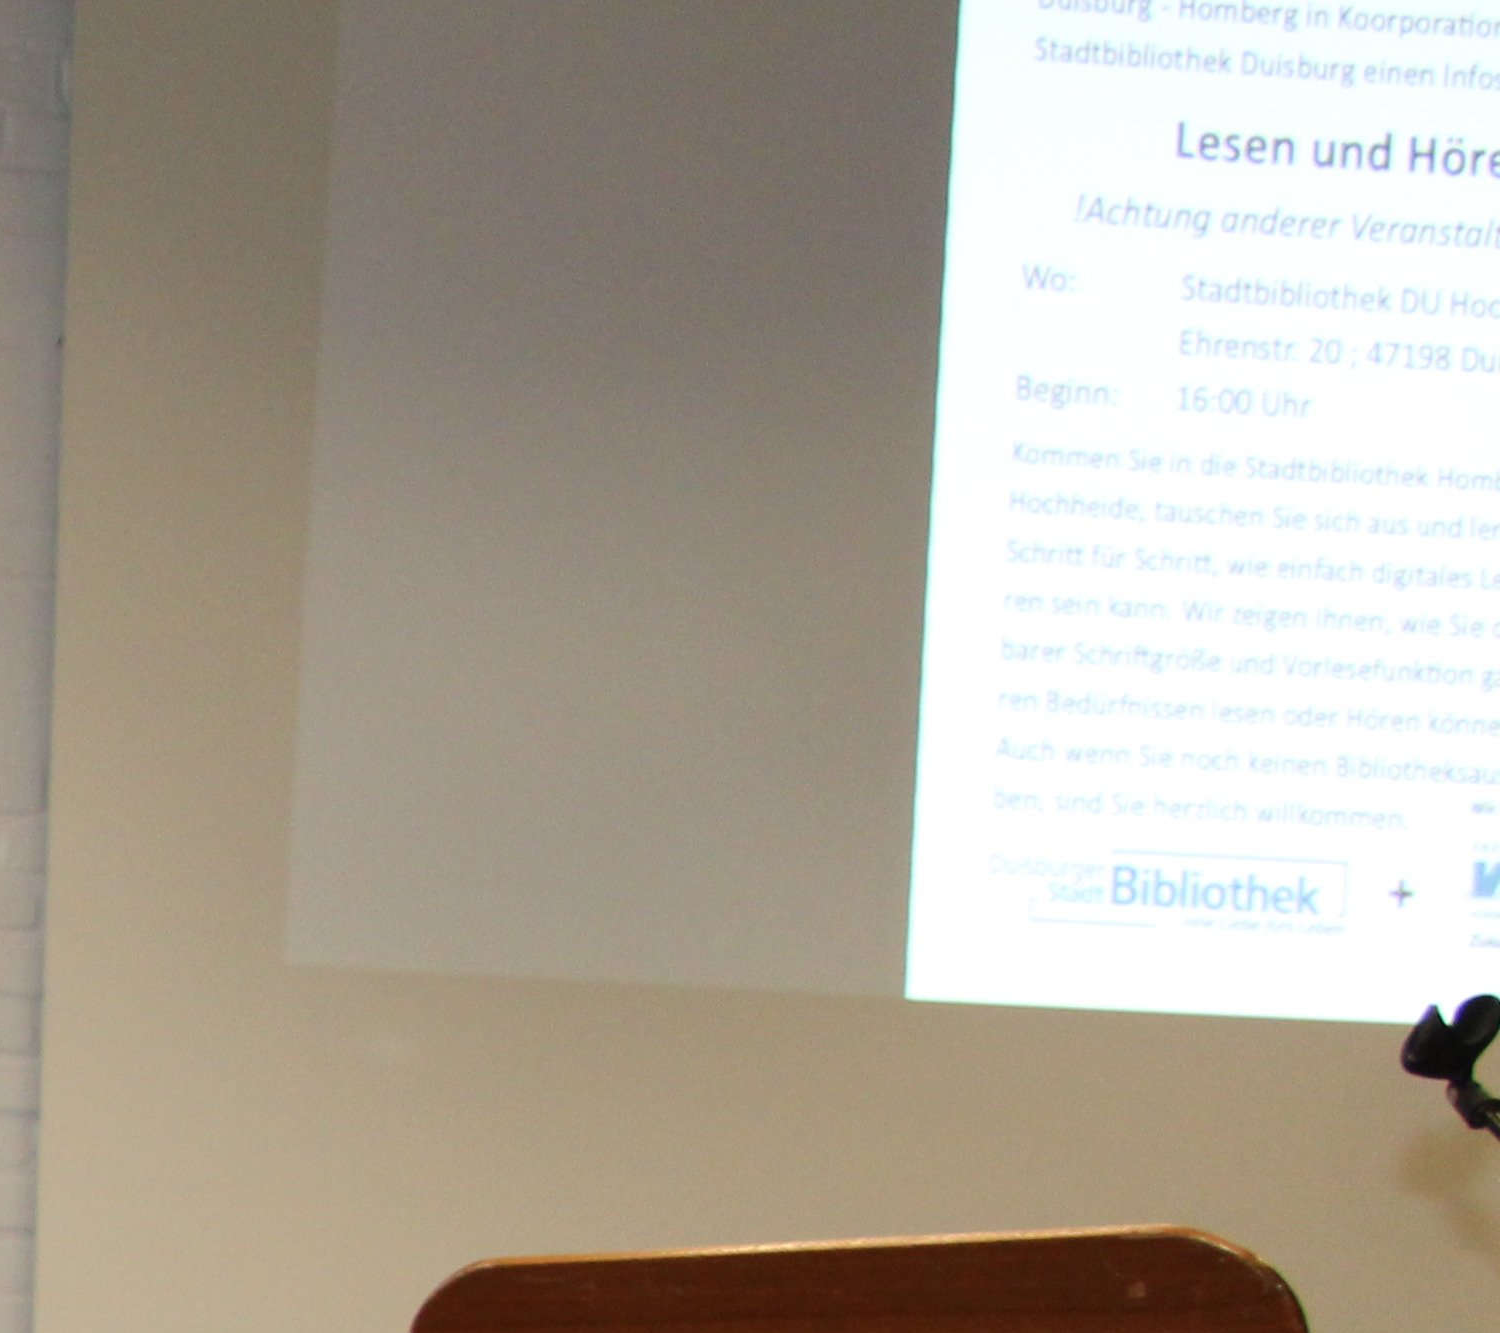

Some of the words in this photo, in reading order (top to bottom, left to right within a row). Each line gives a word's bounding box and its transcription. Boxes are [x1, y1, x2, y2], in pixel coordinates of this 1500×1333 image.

[1179, 0, 1301, 32] Homberg
[1307, 4, 1330, 26] in
[1035, 34, 1232, 74] Stadtbibliothek
[1242, 48, 1358, 88] Duisburg
[1363, 59, 1437, 86] einen
[1176, 119, 1297, 165] Lesen
[1313, 130, 1395, 172] und
[1074, 192, 1214, 239] !Achtung
[1221, 205, 1344, 239] anderer
[1182, 272, 1392, 312] Stadtbibliothek
[1401, 285, 1443, 316] DU
[1309, 335, 1345, 365] 20
[1367, 340, 1453, 372] 47198
[1178, 384, 1255, 415] 16:00
[1262, 390, 1314, 418] Uhr
[1337, 753, 1500, 785] Bibliotheksau
[1110, 864, 1322, 917] Bibliothek
